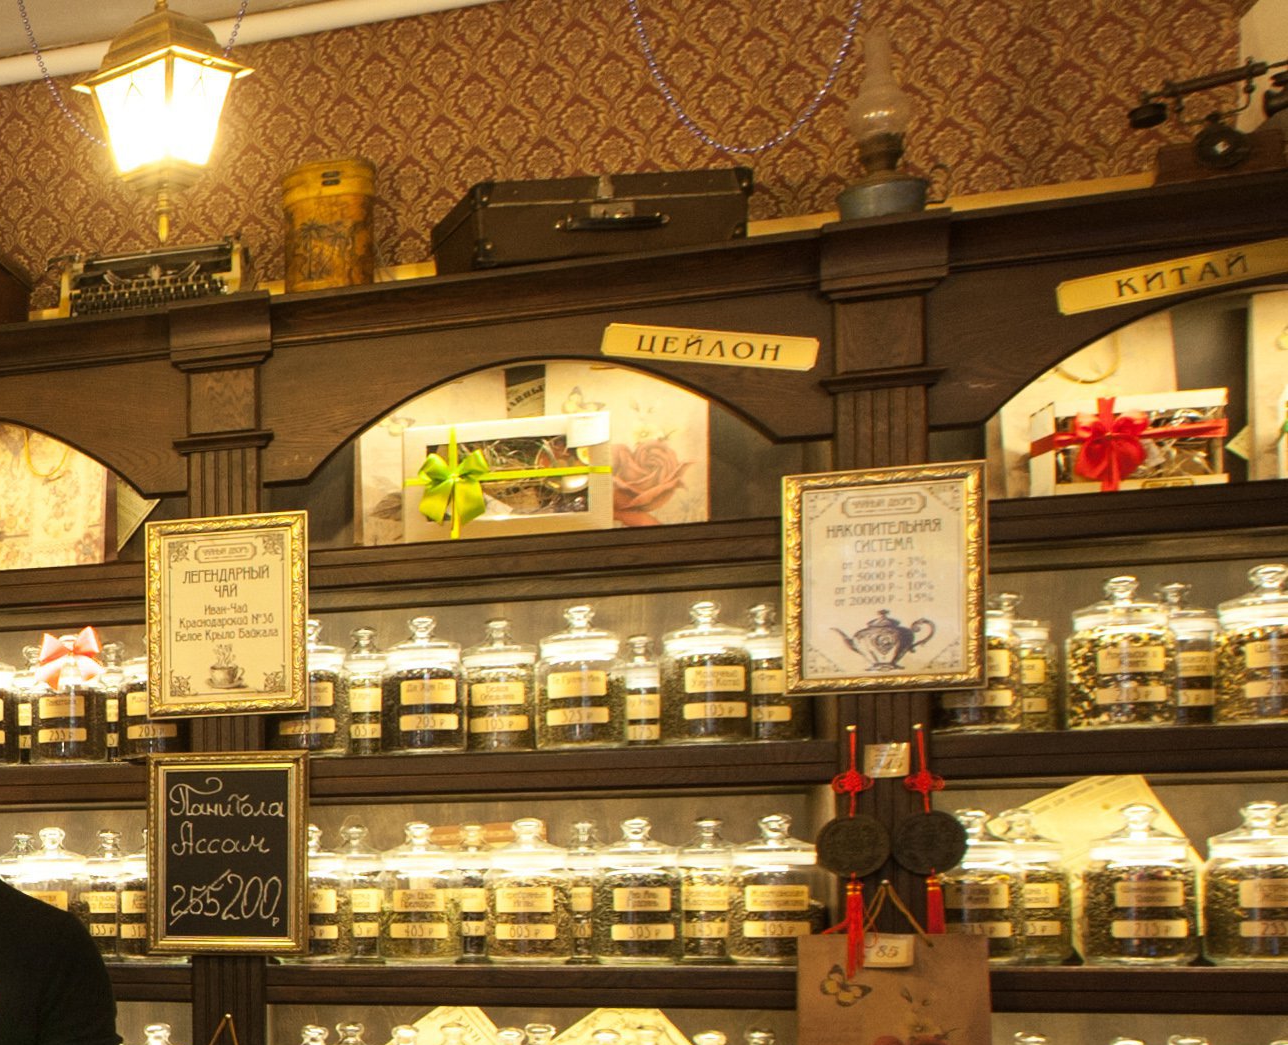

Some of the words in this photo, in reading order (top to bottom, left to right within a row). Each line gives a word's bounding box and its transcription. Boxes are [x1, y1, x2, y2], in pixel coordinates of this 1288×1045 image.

[1115, 252, 1249, 297] КИТАЙ
[635, 332, 783, 363] ЦЕЙЛОН
[825, 517, 943, 539] НАКОПИТЕЛЬНАЯ
[853, 536, 914, 554] СИСТЕМА
[182, 564, 270, 585] ЛЕГЕНДАРНЫЙ
[214, 584, 238, 599] ЧАЙ
[204, 603, 248, 616] Иван-Чай
[178, 615, 249, 629] Краснодарский
[175, 631, 203, 642] Белое
[205, 629, 236, 642] Крыло
[238, 627, 279, 639] Байкала
[171, 820, 271, 856] Ассам
